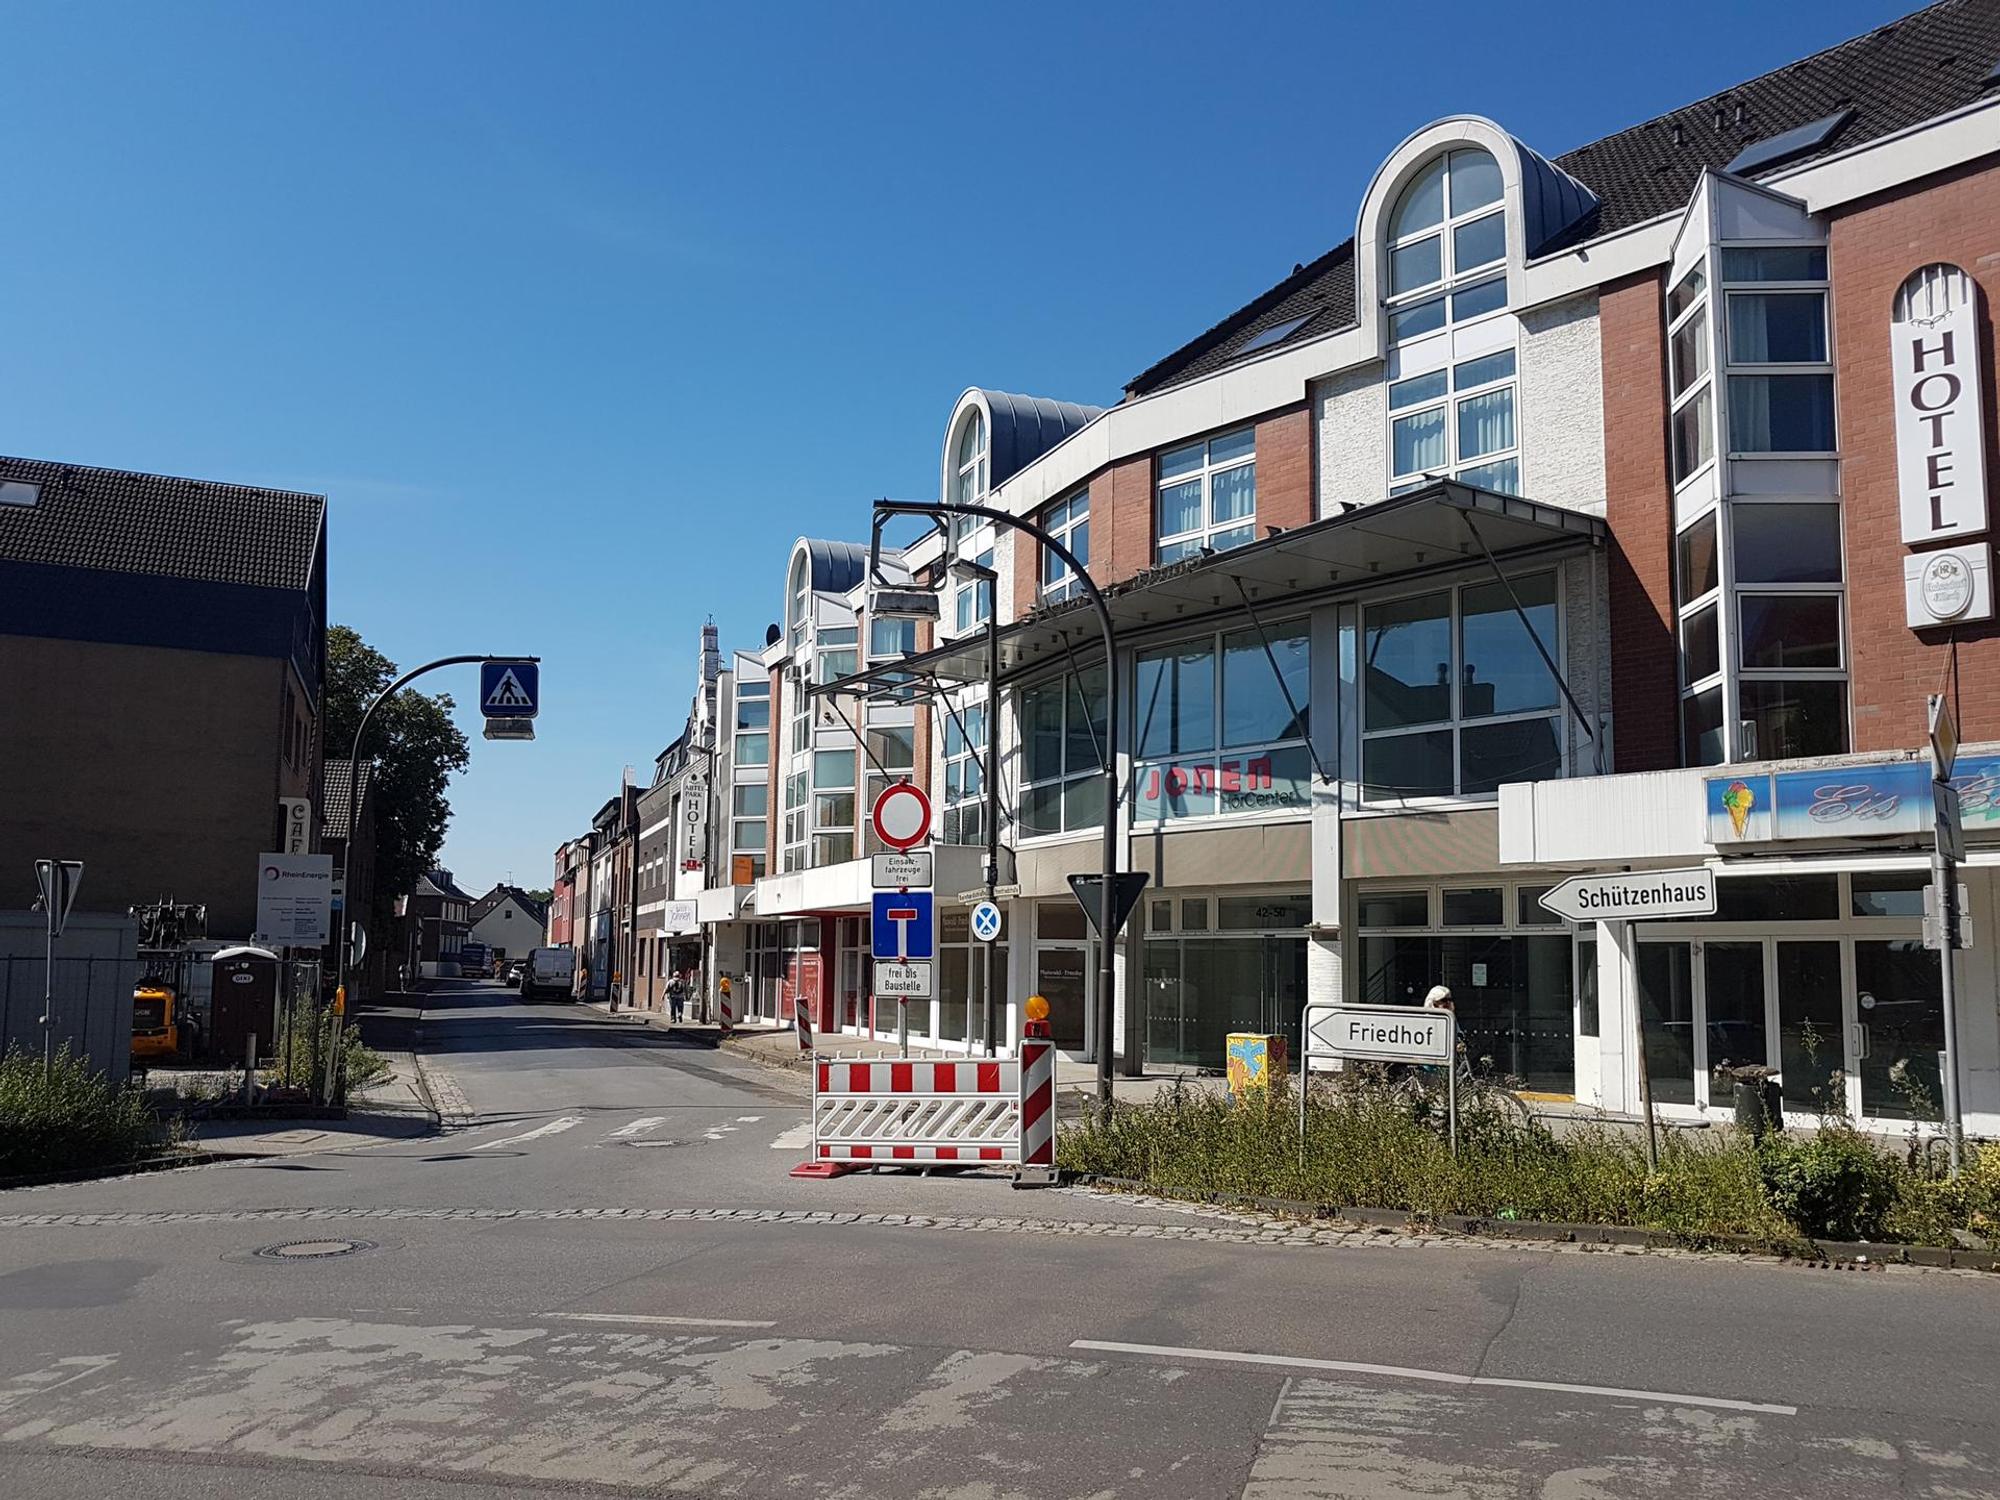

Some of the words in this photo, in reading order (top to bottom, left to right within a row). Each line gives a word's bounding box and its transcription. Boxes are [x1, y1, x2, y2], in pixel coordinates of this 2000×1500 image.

[1911, 331, 1961, 530] HOTEL
[1808, 785, 1899, 822] Eis
[687, 799, 699, 859] HOTEL
[281, 871, 329, 880] RheinEnergie
[885, 866, 921, 874] fahrzeuge
[896, 875, 909, 883] frei
[1578, 882, 1706, 908] Schützenhaus
[1255, 906, 1286, 918] 42-50
[888, 967, 902, 979] frei
[905, 967, 917, 979] bis
[884, 981, 921, 991] Baustelle
[1349, 1022, 1433, 1046] Friedhof
